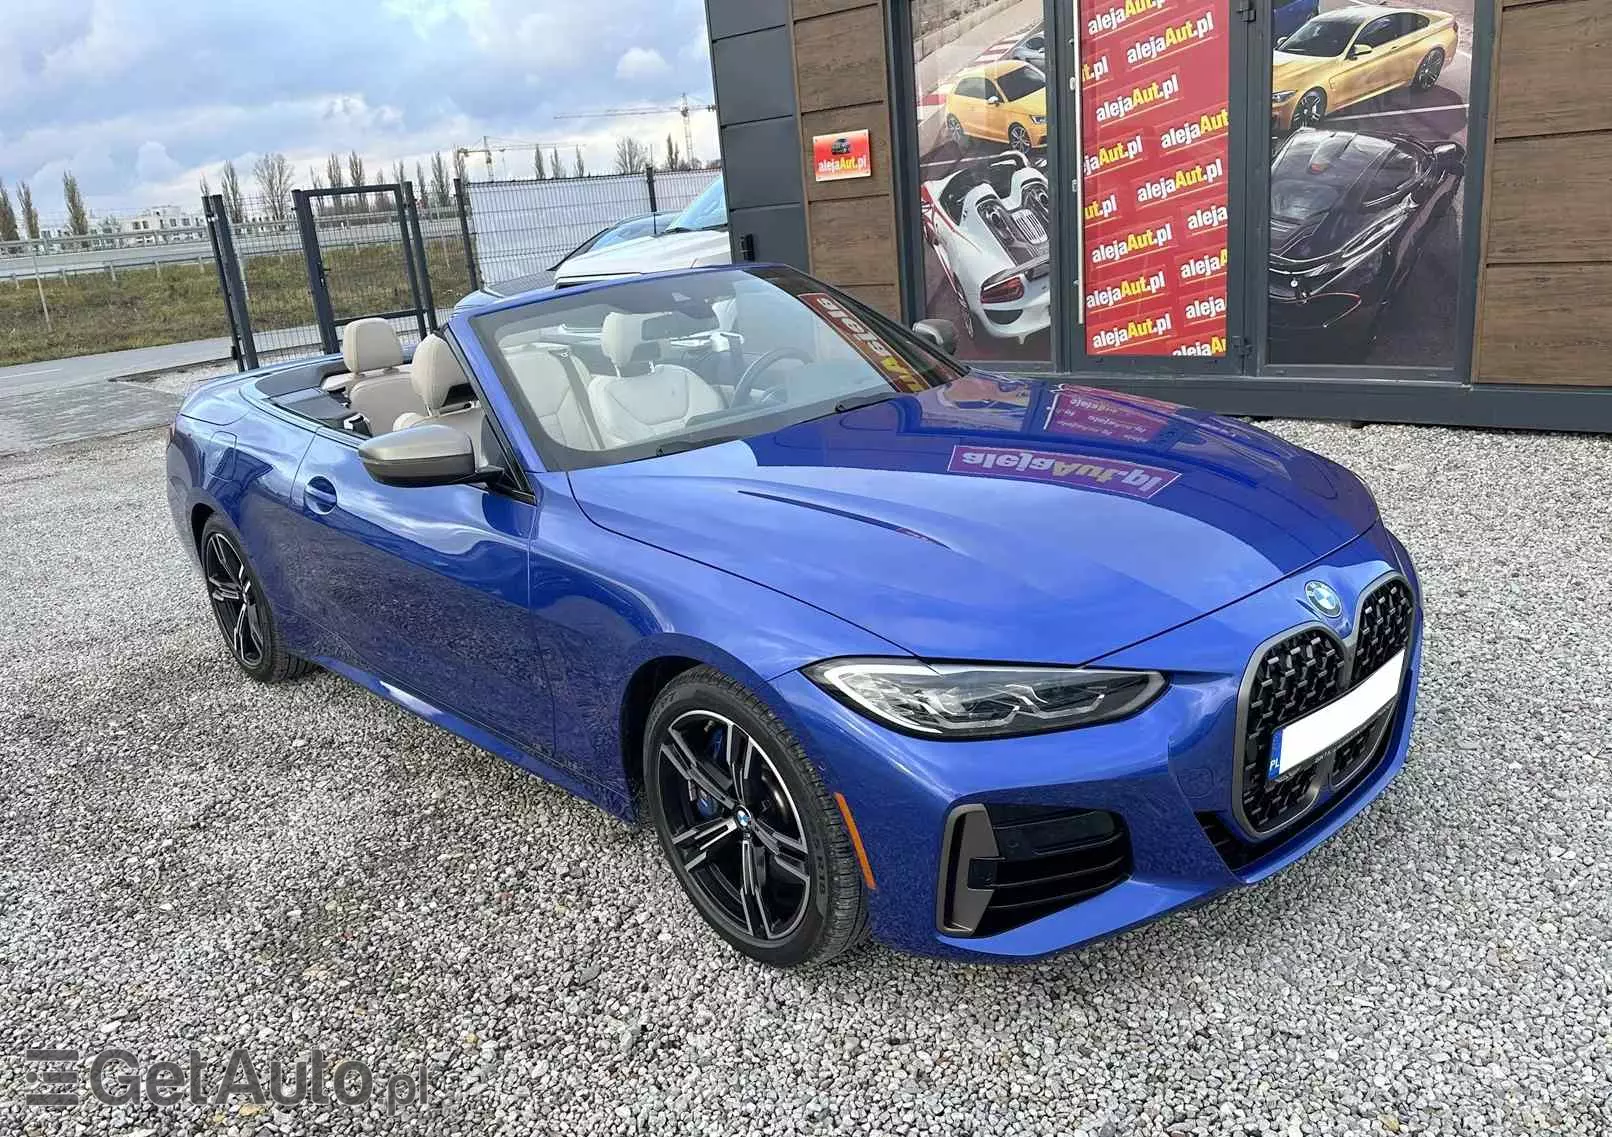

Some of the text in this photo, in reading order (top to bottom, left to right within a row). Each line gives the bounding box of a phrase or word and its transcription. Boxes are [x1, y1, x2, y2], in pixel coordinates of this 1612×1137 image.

[1127, 11, 1213, 63] alejaAut.pl
[1096, 74, 1179, 122] alejaAut.pl
[1160, 109, 1228, 148] alejaAut
[1137, 159, 1222, 201] alejaAut.pl
[1187, 205, 1228, 229] aleja
[1091, 224, 1172, 263] alejaAut.pl
[1086, 271, 1165, 308] alejaAut.pl
[1185, 296, 1226, 319] aleja
[1092, 313, 1172, 348] alejaAut.pl
[1269, 758, 1280, 770] PL
